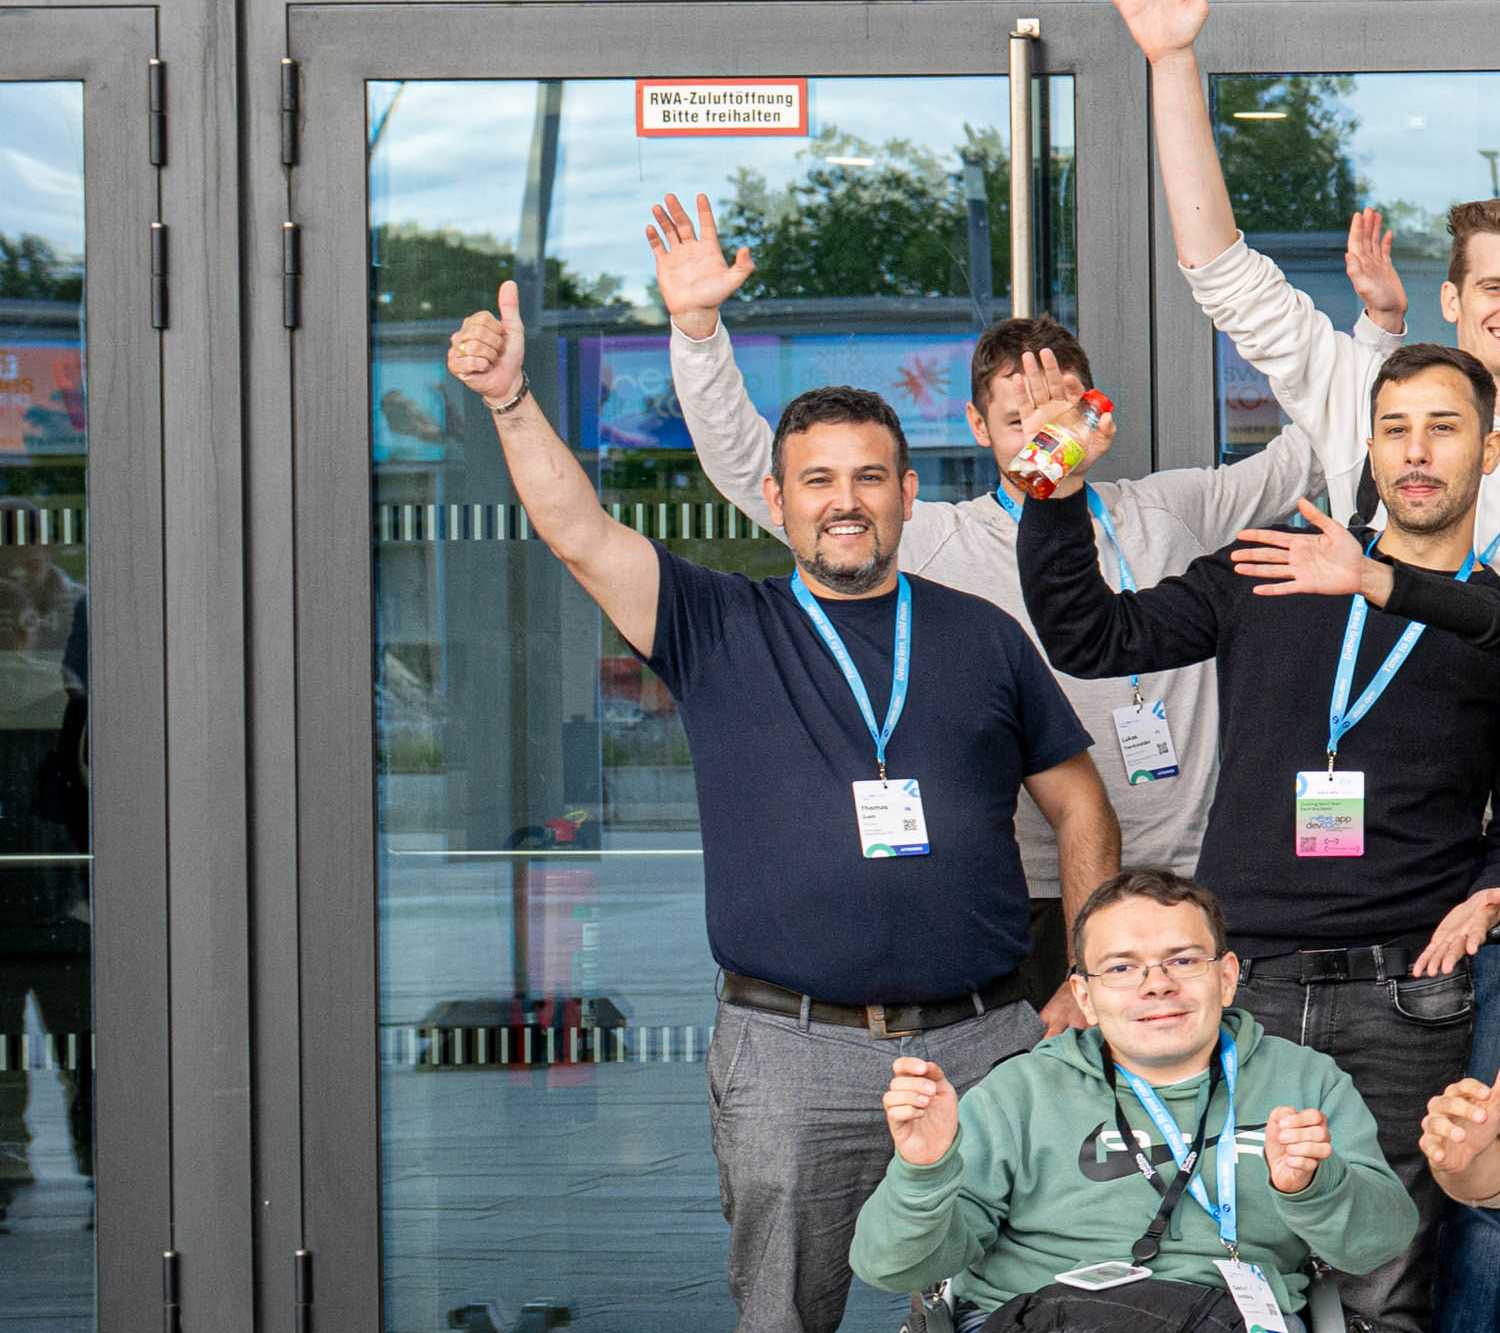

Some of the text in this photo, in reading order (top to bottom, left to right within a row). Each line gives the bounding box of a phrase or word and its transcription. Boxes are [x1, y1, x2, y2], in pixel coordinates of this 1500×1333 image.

[650, 90, 794, 107] RWA-Zuluftöffnung
[662, 108, 781, 123] Bitte freihalten
